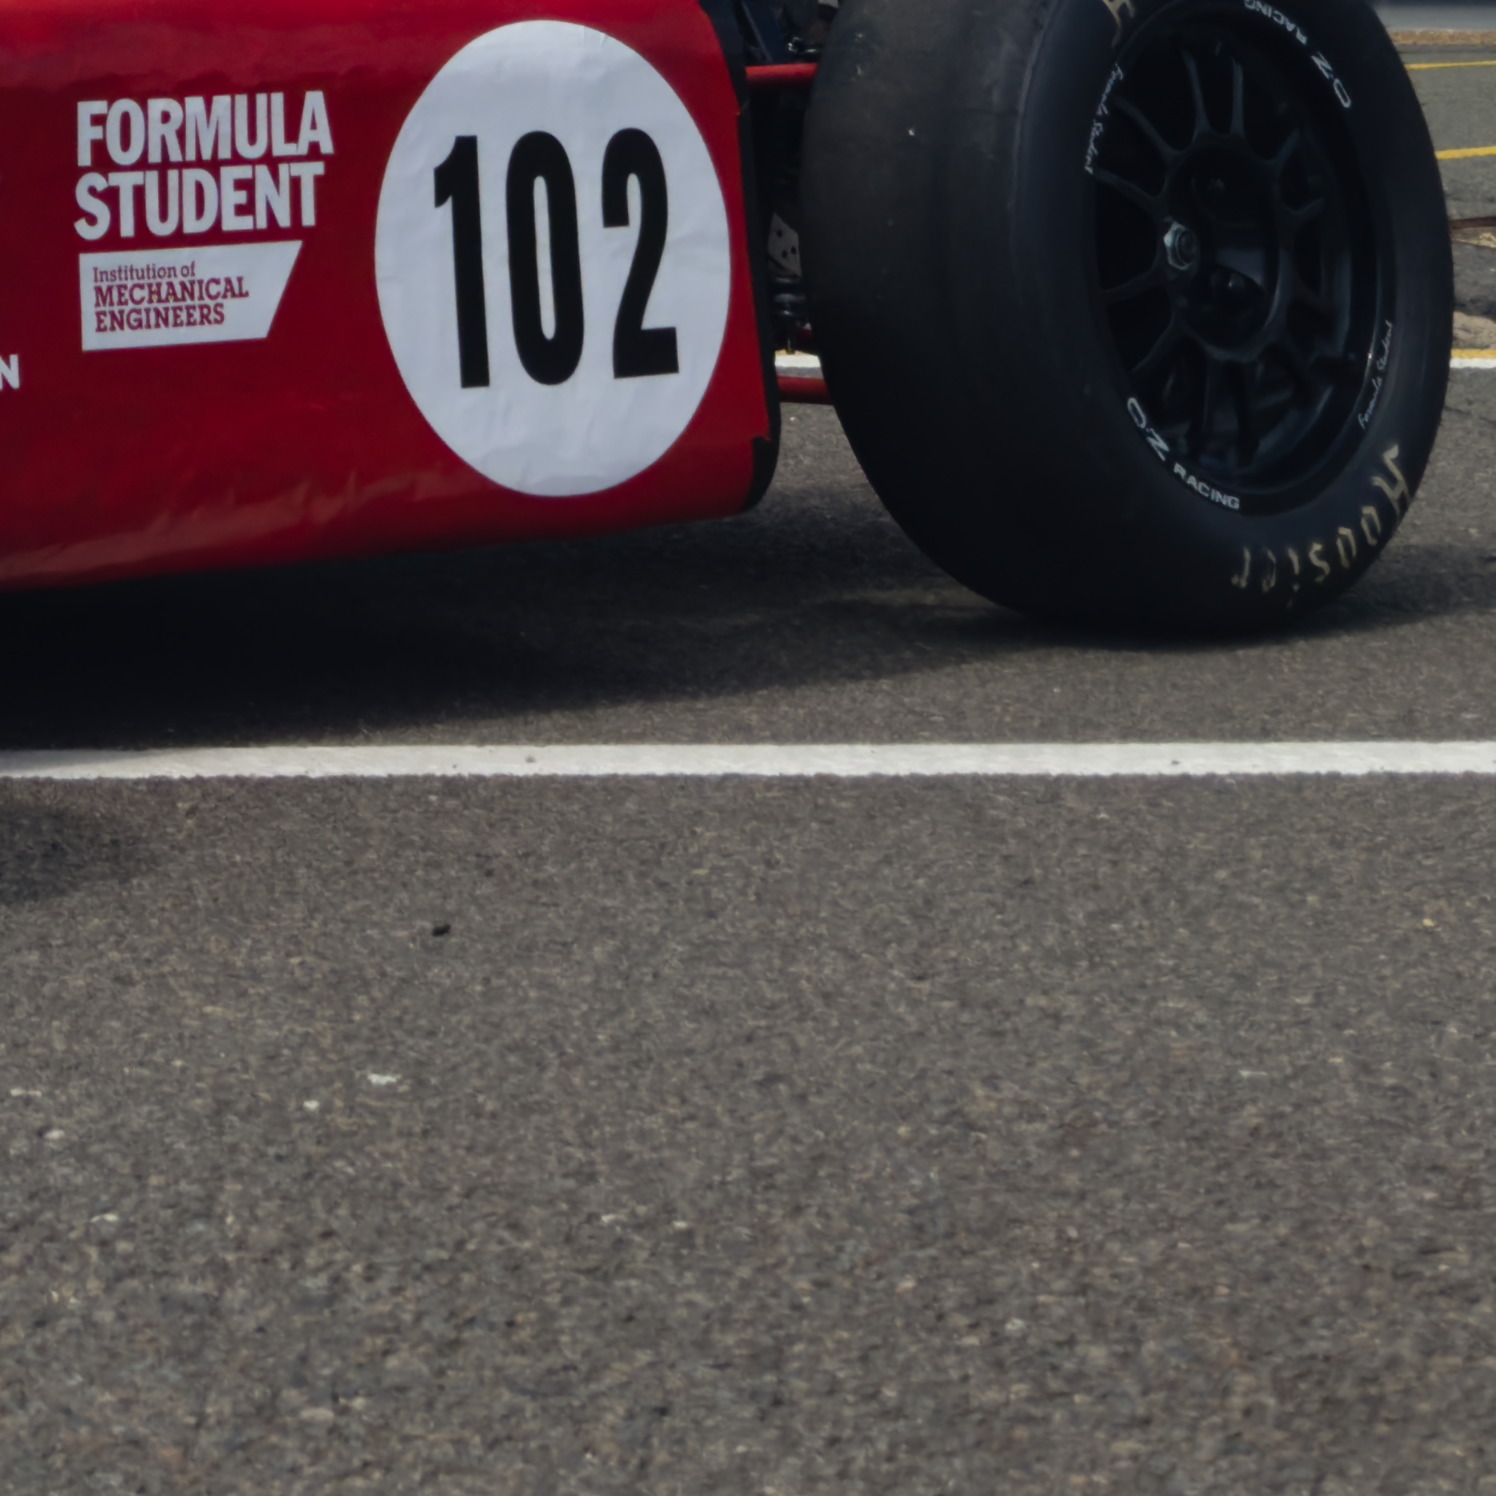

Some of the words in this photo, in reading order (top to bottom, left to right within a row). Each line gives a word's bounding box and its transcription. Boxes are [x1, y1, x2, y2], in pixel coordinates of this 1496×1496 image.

[75, 90, 335, 167] FORMULA
[74, 162, 326, 241] STUDENT
[92, 264, 176, 284] Institution
[179, 261, 197, 279] of
[433, 127, 680, 389] 102
[92, 276, 250, 309] MECHANICAL
[94, 302, 226, 334] ENGINEERS
[1173, 462, 1241, 510] RACING
